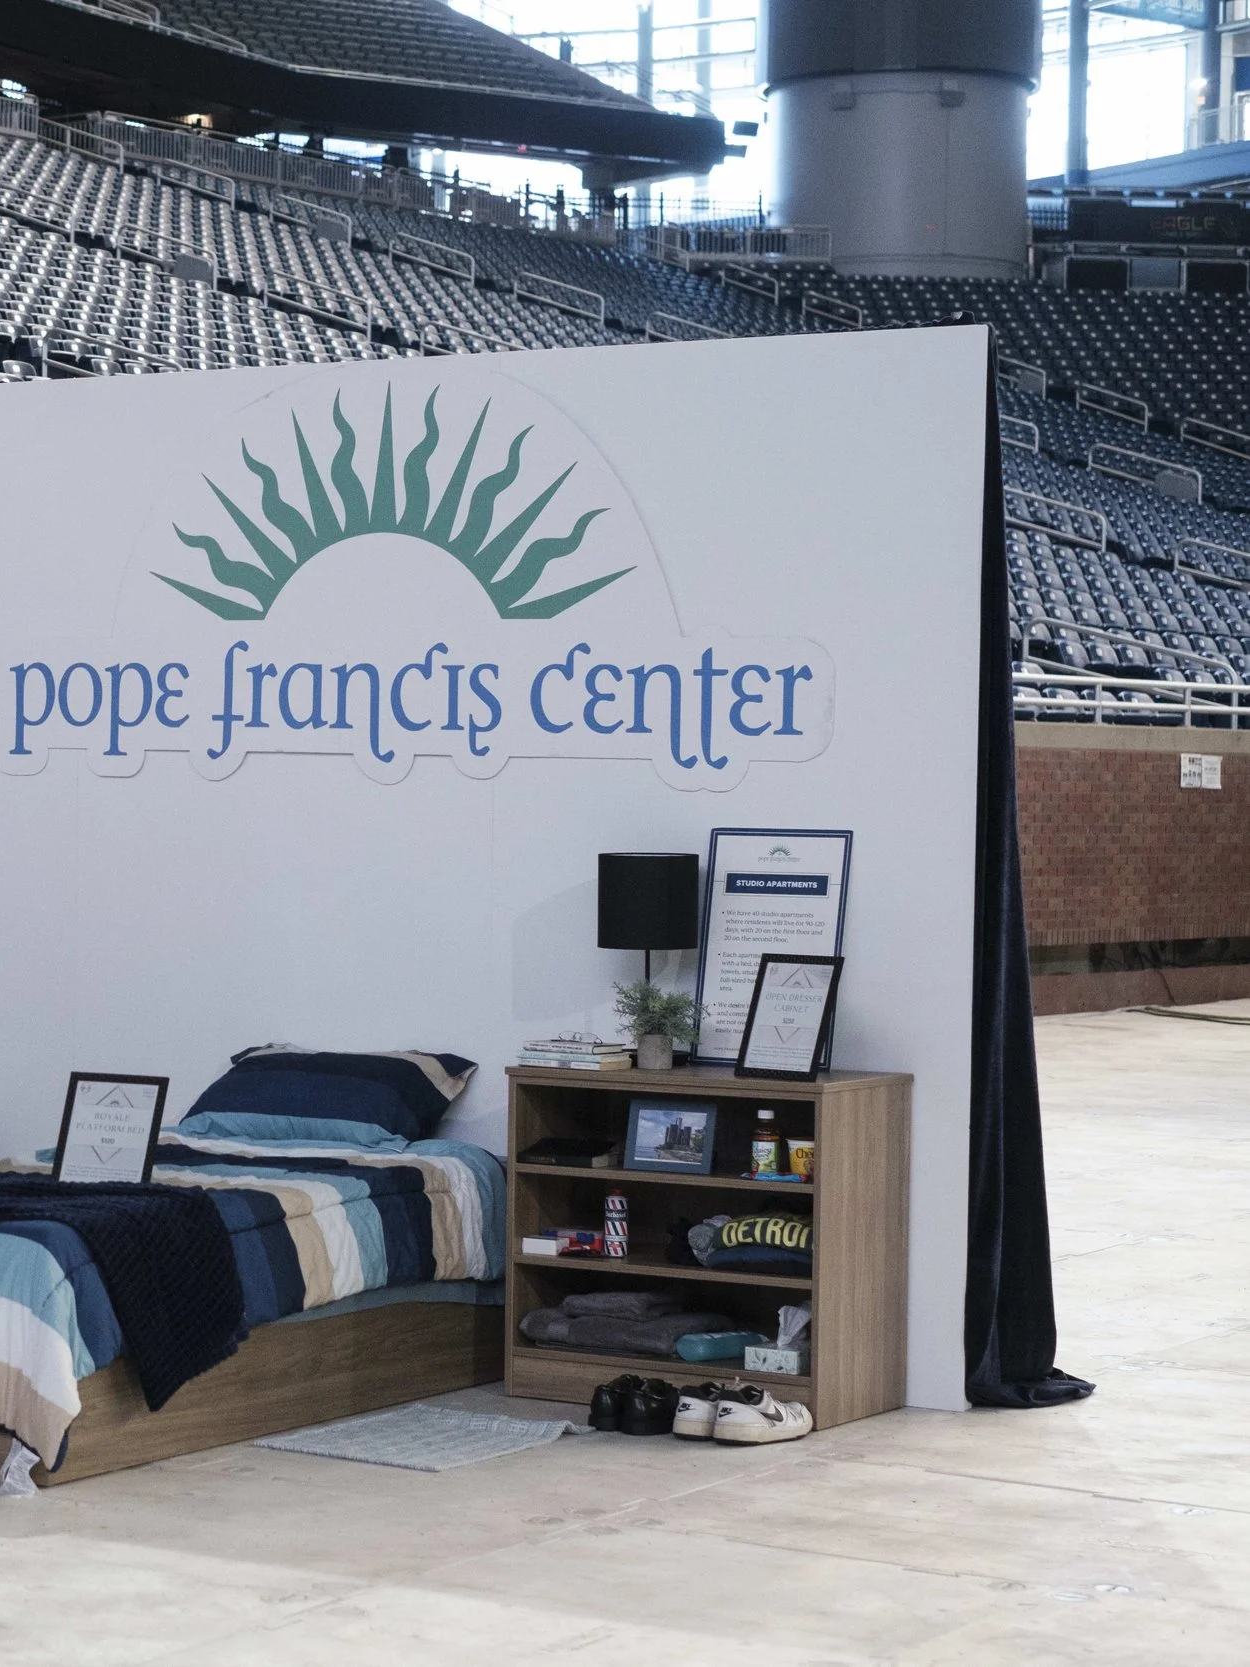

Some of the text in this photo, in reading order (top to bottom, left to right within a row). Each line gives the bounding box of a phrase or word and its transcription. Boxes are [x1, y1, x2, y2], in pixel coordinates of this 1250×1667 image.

[9, 640, 813, 770] pope francis center
[736, 879, 818, 889] STUDIO APARTMENTS
[774, 1005, 810, 1013] CABINET
[94, 1113, 130, 1122] ROYALE
[76, 1123, 145, 1134] PLATFORM BED
[722, 1218, 812, 1248] DETROI
